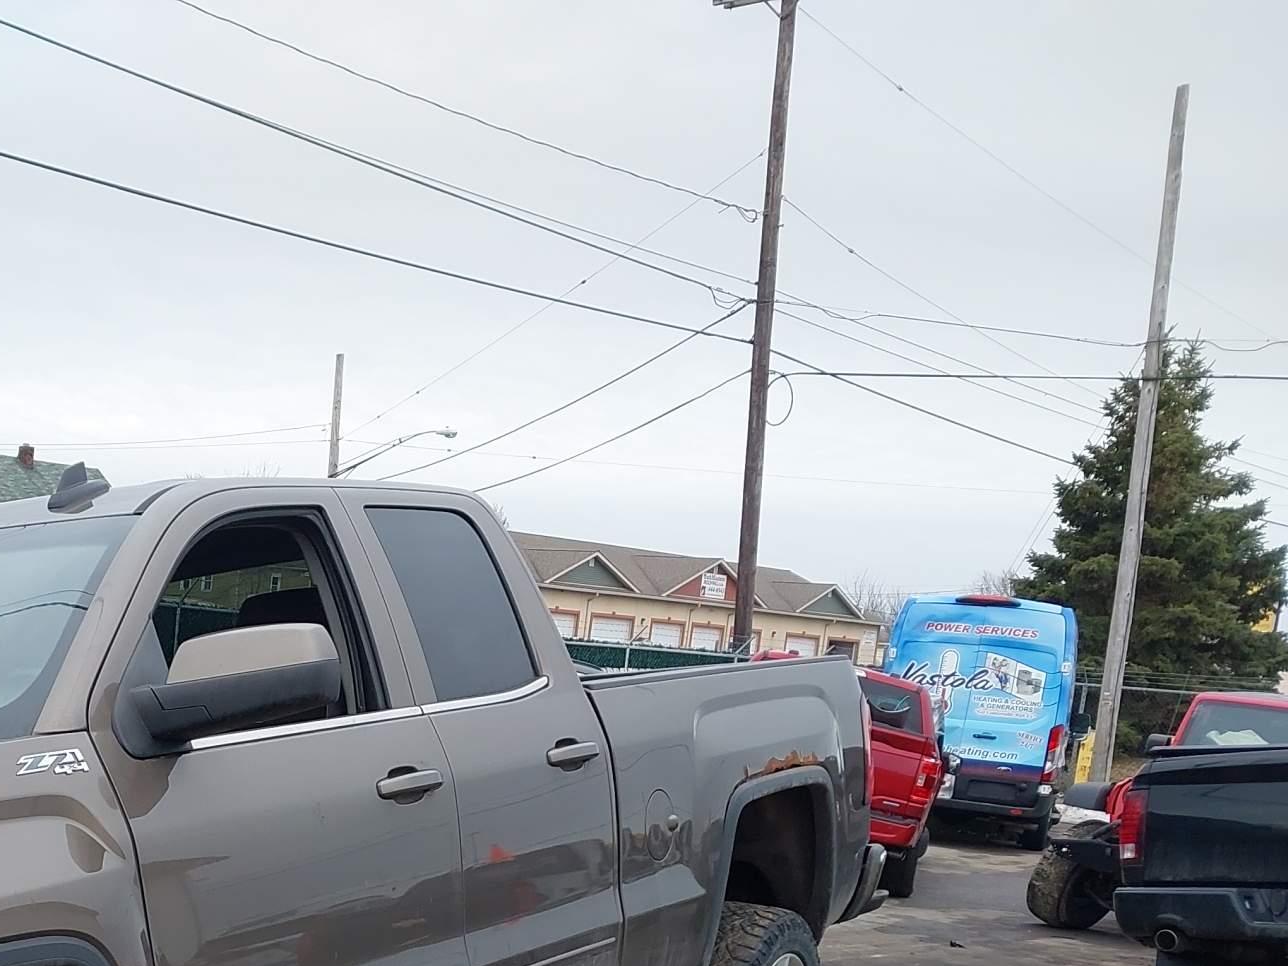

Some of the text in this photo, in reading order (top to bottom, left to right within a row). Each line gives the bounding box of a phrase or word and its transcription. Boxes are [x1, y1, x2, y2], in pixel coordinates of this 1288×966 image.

[926, 622, 1039, 639] POWER SERVICES
[902, 662, 993, 691] Vastola
[973, 695, 1003, 704] HEATING
[1011, 699, 1042, 707] COOLING
[986, 703, 1033, 712] GENERATORS
